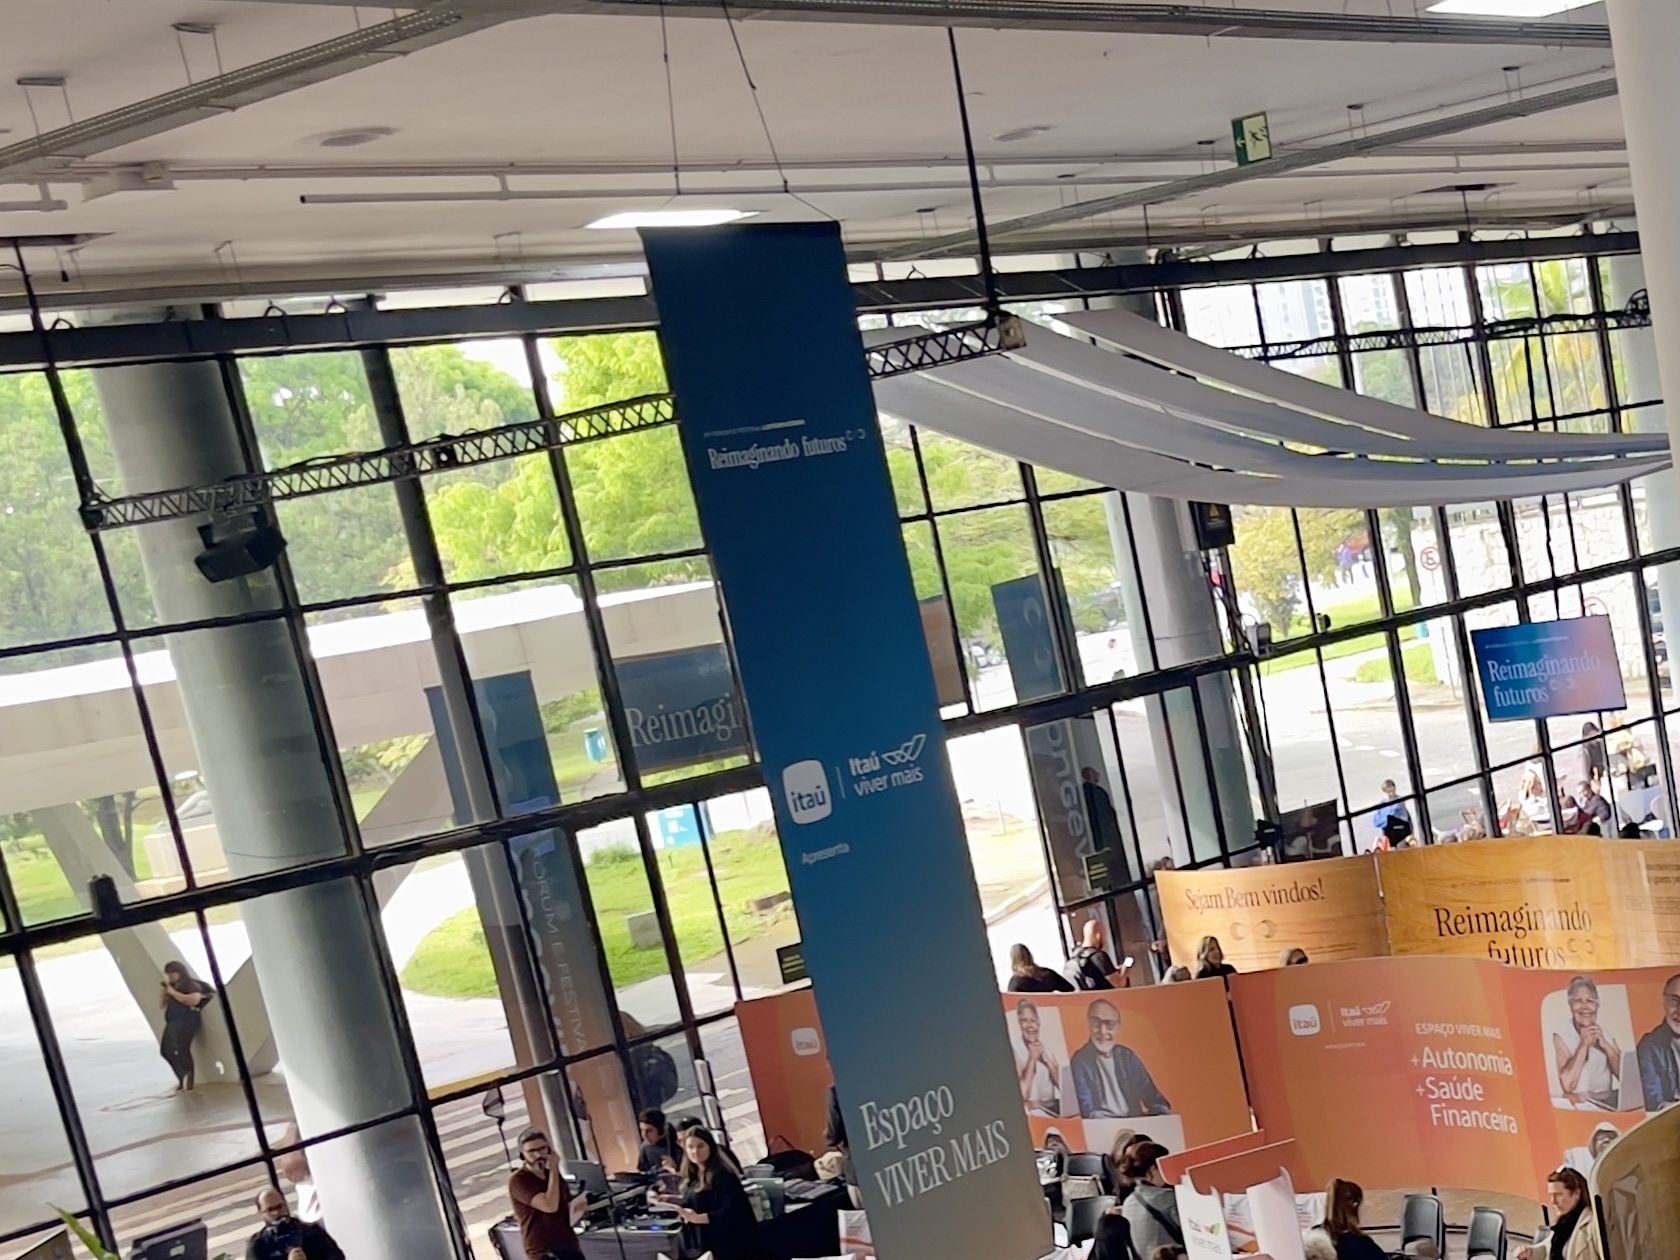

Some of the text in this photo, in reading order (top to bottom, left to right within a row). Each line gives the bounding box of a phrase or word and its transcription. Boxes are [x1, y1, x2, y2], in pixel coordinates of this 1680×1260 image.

[707, 435, 848, 469] Reimaginando futuros
[1486, 651, 1601, 683] Reimaginando
[1493, 685, 1550, 708] futuros
[849, 750, 881, 777] Itaú
[853, 764, 925, 797] viver mais
[790, 785, 827, 813] itaú
[1186, 877, 1326, 915] Sejam Bem vindos!
[1433, 902, 1593, 940] Reimaginando
[1415, 1022, 1503, 1040] ESPAÇO VIVER MAIS
[858, 1085, 955, 1151] Espaço
[1430, 1103, 1518, 1135] Financeira
[873, 1119, 1011, 1209] VIVER MAIS
